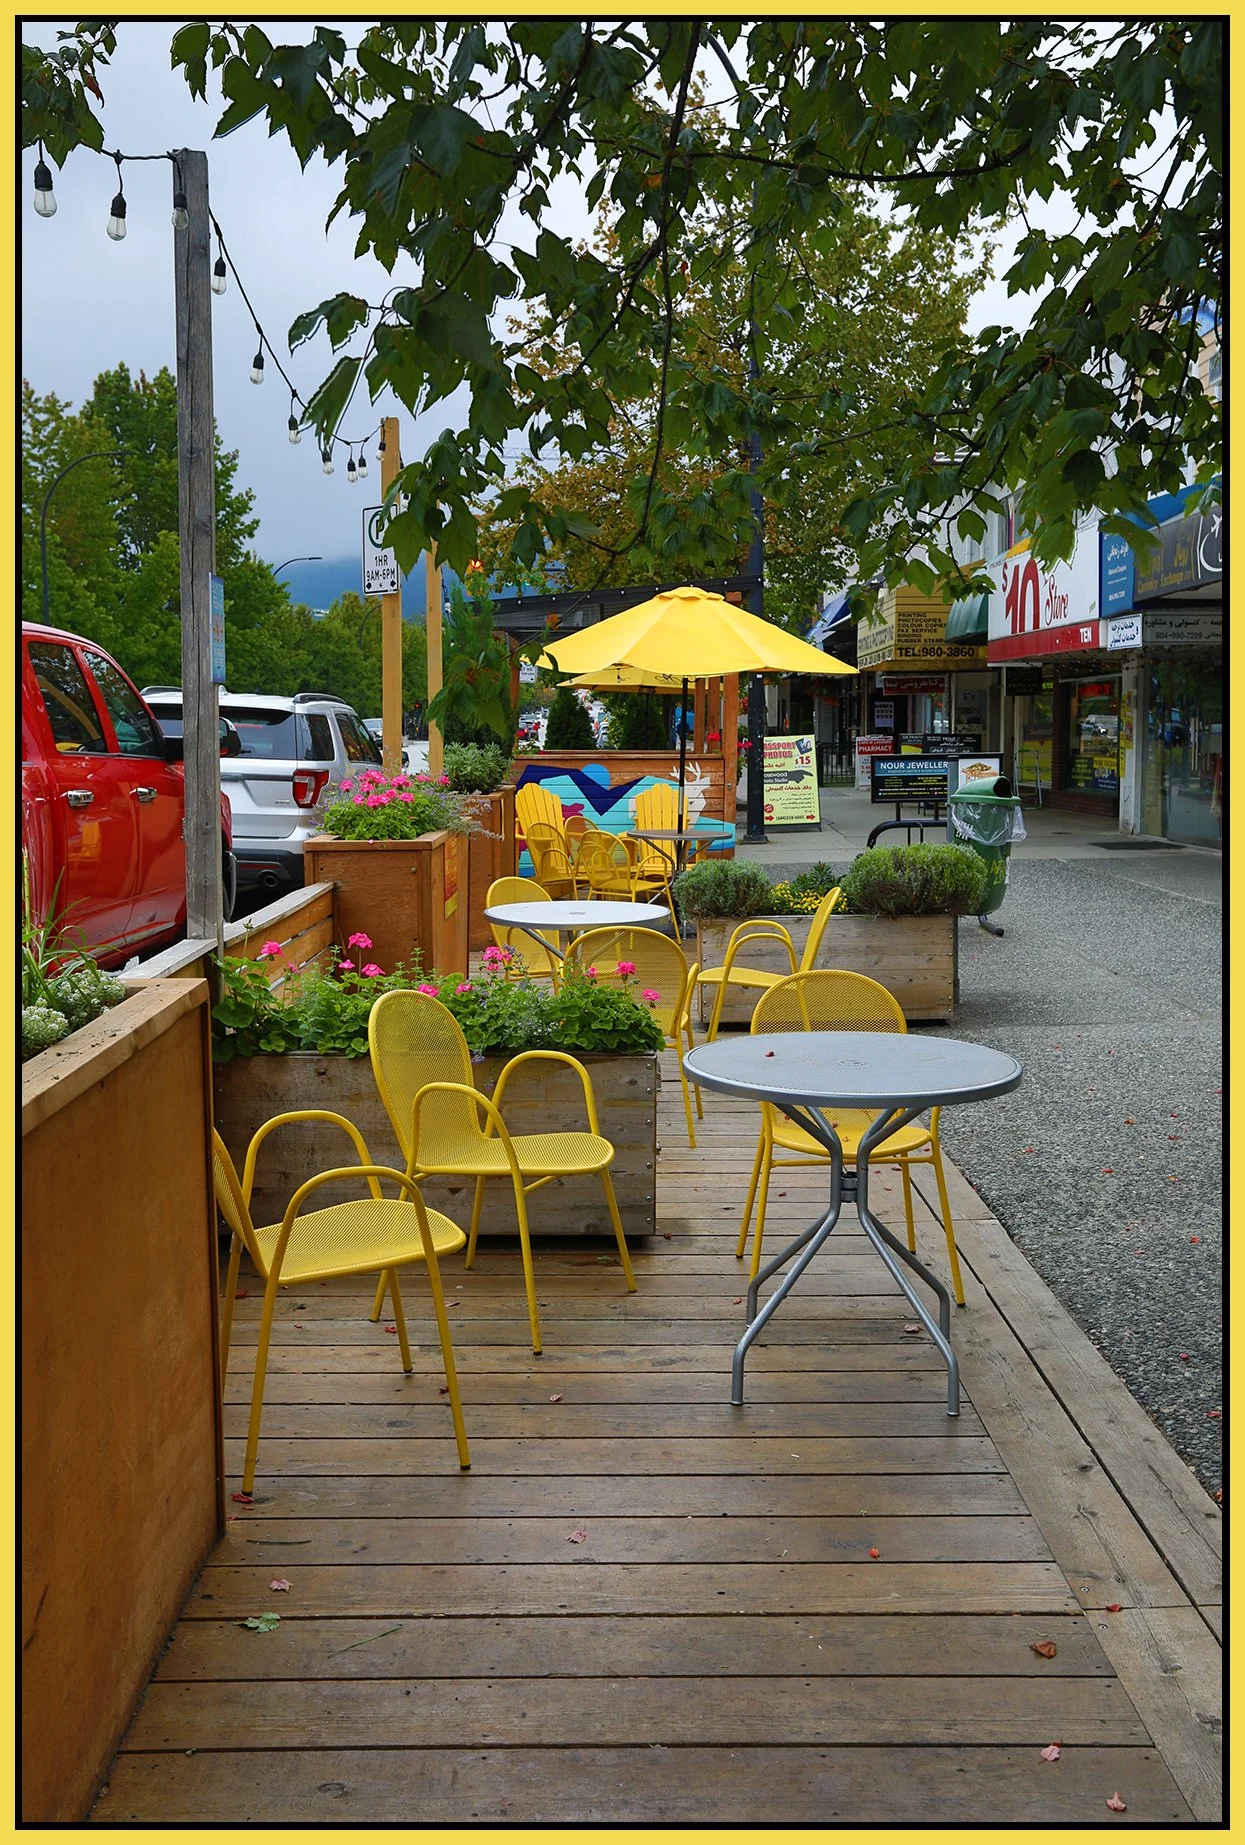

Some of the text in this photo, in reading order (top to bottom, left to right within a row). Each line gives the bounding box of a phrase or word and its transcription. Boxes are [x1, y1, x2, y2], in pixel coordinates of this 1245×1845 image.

[366, 567, 396, 582] 9AM-6PM
[1044, 574, 1068, 626] Store
[1080, 627, 1092, 644] TEN
[795, 756, 811, 765] $15
[906, 761, 948, 769] JEWELLER
